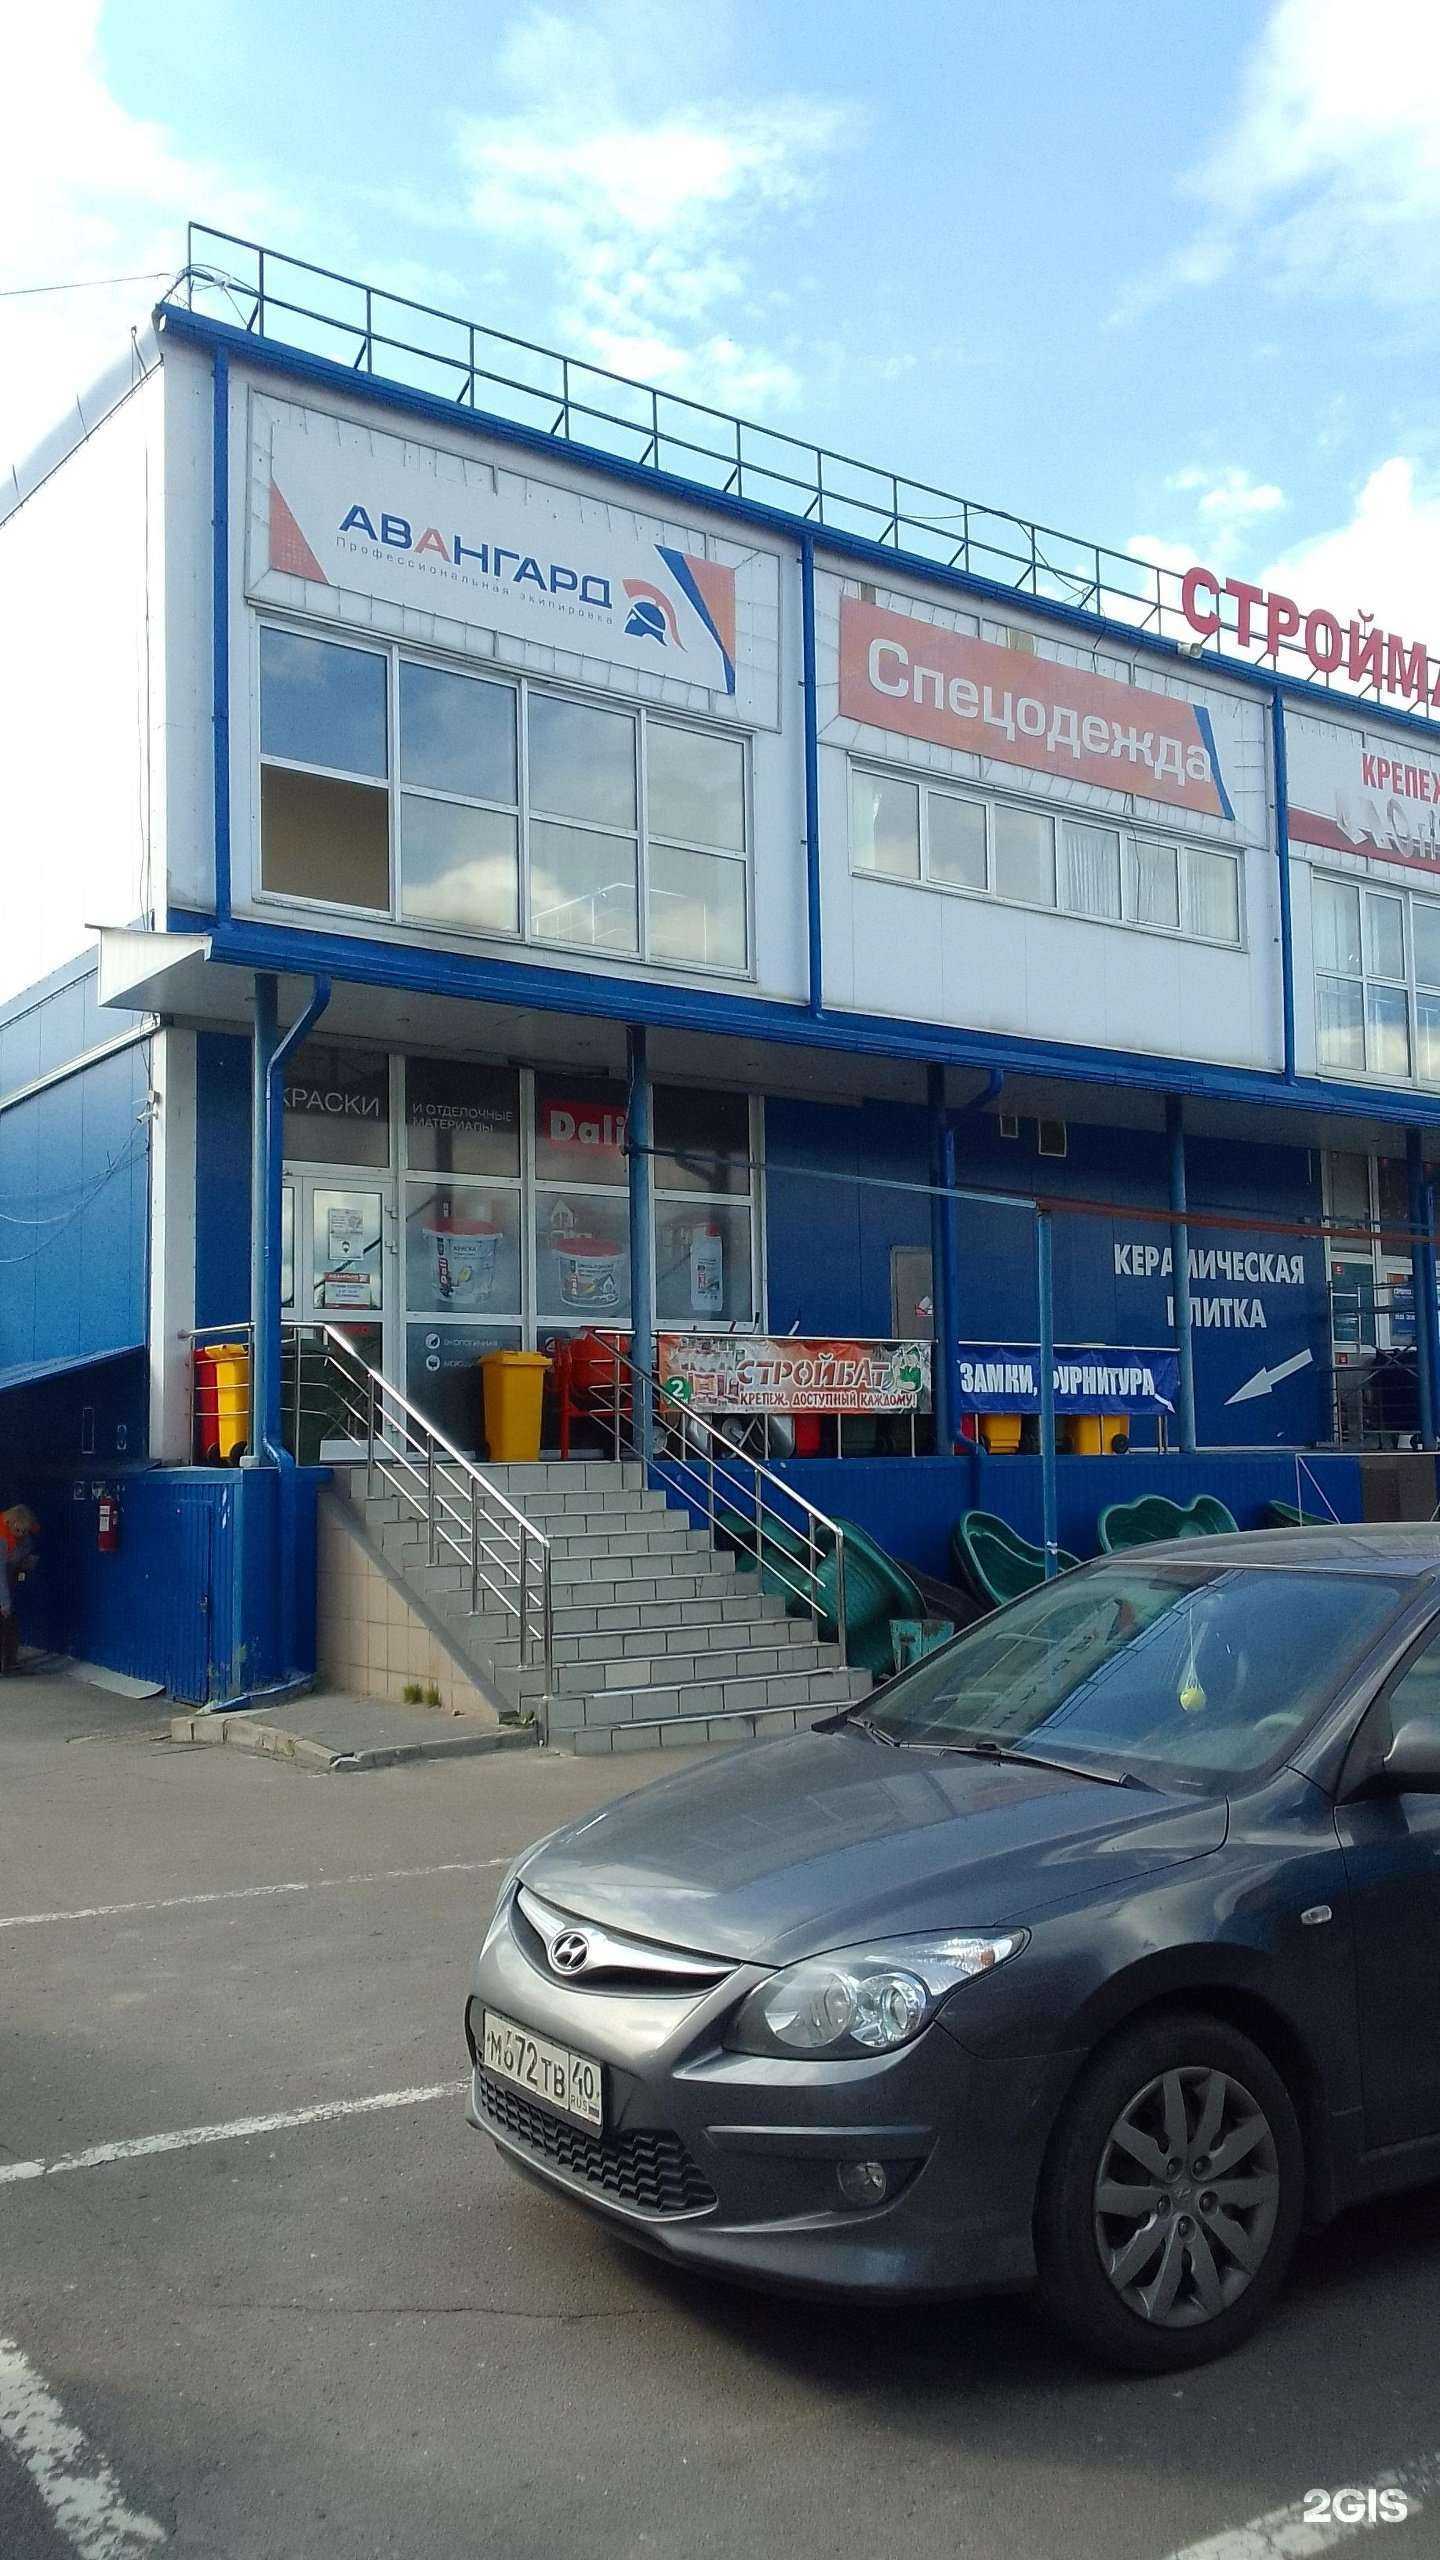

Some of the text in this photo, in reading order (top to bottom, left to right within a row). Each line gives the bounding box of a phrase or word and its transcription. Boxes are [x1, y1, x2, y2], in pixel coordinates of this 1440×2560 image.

[338, 504, 613, 609] АВАНГАРД
[335, 536, 613, 625] Профессиональная экипировка
[867, 637, 1213, 786] Спецодежда
[412, 1103, 513, 1122] И ОТДЕЛОЧНЫЕ
[412, 1118, 494, 1133] МАТЕРИАЛЫ
[550, 1110, 625, 1146] Dali
[671, 1380, 684, 1397] 2
[736, 1353, 890, 1389] СТРОЙБАТ
[960, 1362, 1155, 1397] ЗАМКИ, УРНИТУРА
[793, 1391, 856, 1408] ДОСТУПНЫЙ
[857, 1393, 918, 1409] КАЖДОМУ!
[572, 2061, 594, 2099] 40
[570, 2095, 588, 2110] RUS
